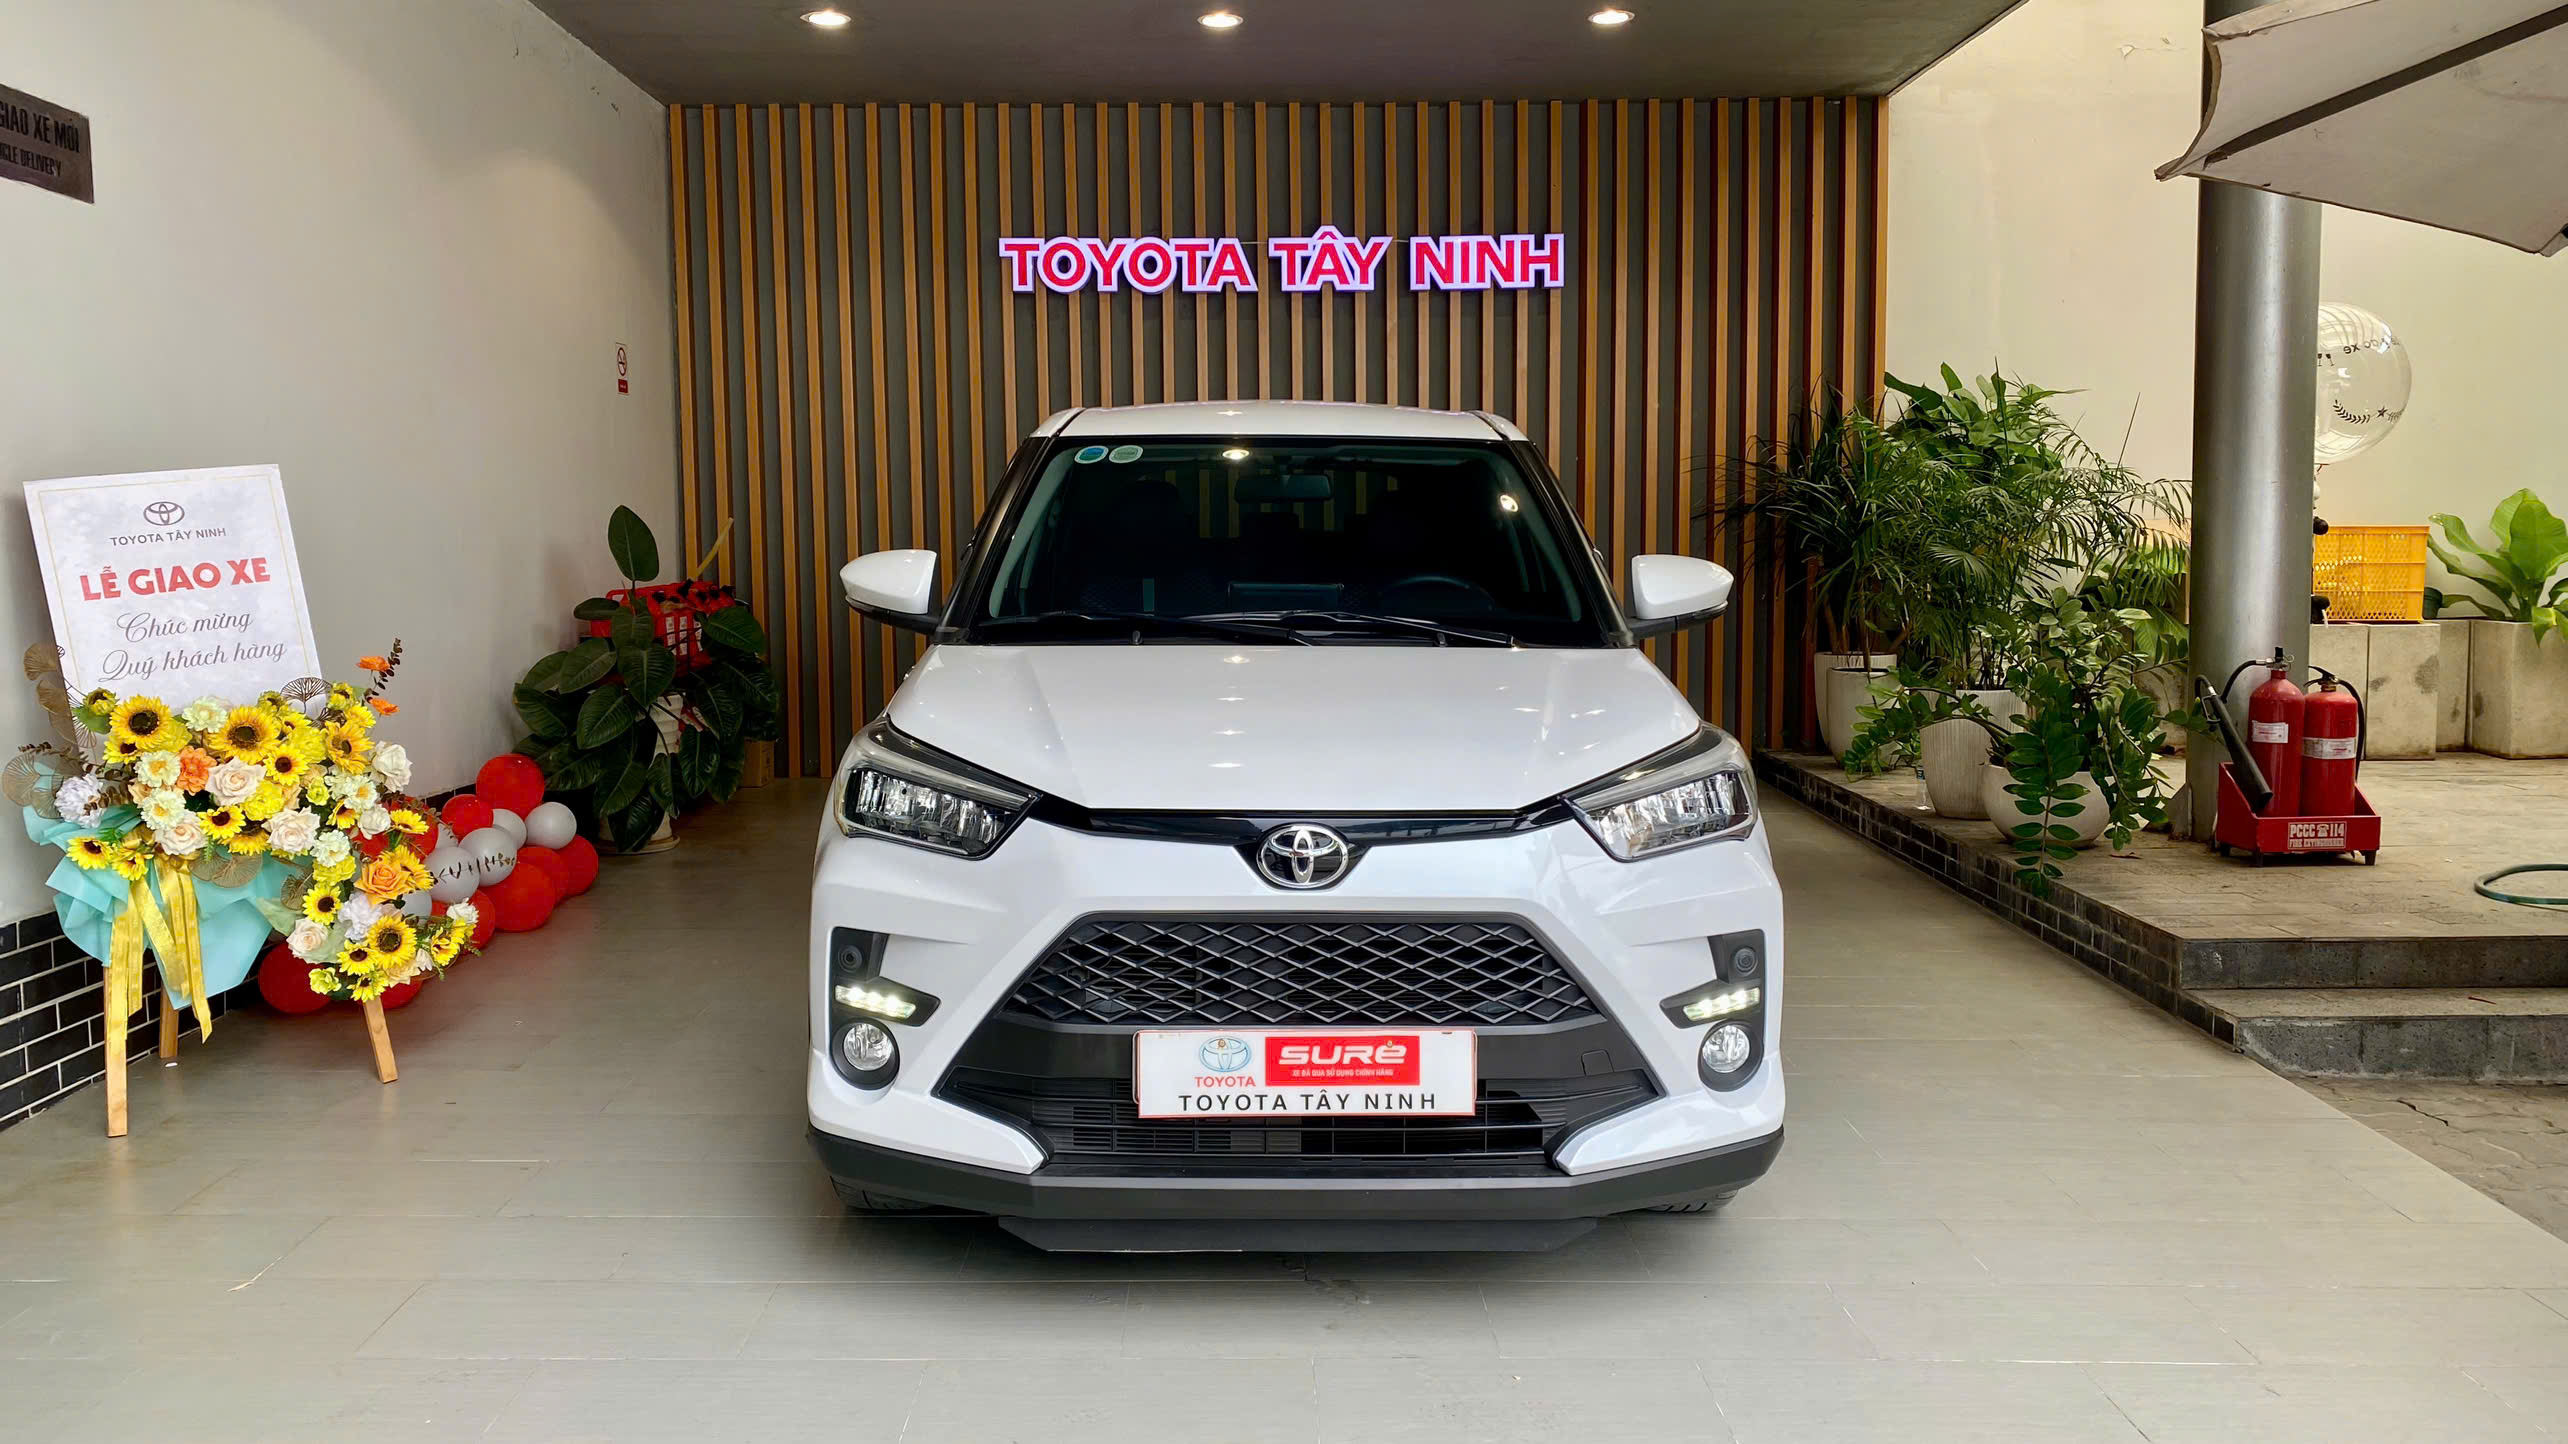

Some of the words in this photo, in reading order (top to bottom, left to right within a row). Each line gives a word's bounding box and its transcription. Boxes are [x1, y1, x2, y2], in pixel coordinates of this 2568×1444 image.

[33, 112, 51, 144] XE
[999, 236, 1258, 293] TOYOTA
[1268, 225, 1393, 292] TÂY
[1410, 233, 1565, 291] NINH
[109, 533, 164, 547] TOYOTA
[166, 529, 192, 541] TÂY
[195, 527, 227, 539] NINH
[79, 565, 121, 601] LỄ
[127, 562, 222, 596] GIAO
[226, 557, 271, 586] XE
[116, 612, 188, 643] Chúc
[192, 612, 254, 634] mừng
[98, 649, 157, 683] Quý
[163, 645, 228, 671] khách
[233, 640, 288, 664] hàng
[2290, 823, 2316, 838] PCCC
[2330, 823, 2345, 838] 114
[1194, 1076, 1256, 1088] TOYOTA
[1178, 1093, 1288, 1112] TOYOTA
[1300, 1089, 1351, 1110] TÂY
[1364, 1092, 1436, 1110] NINH
